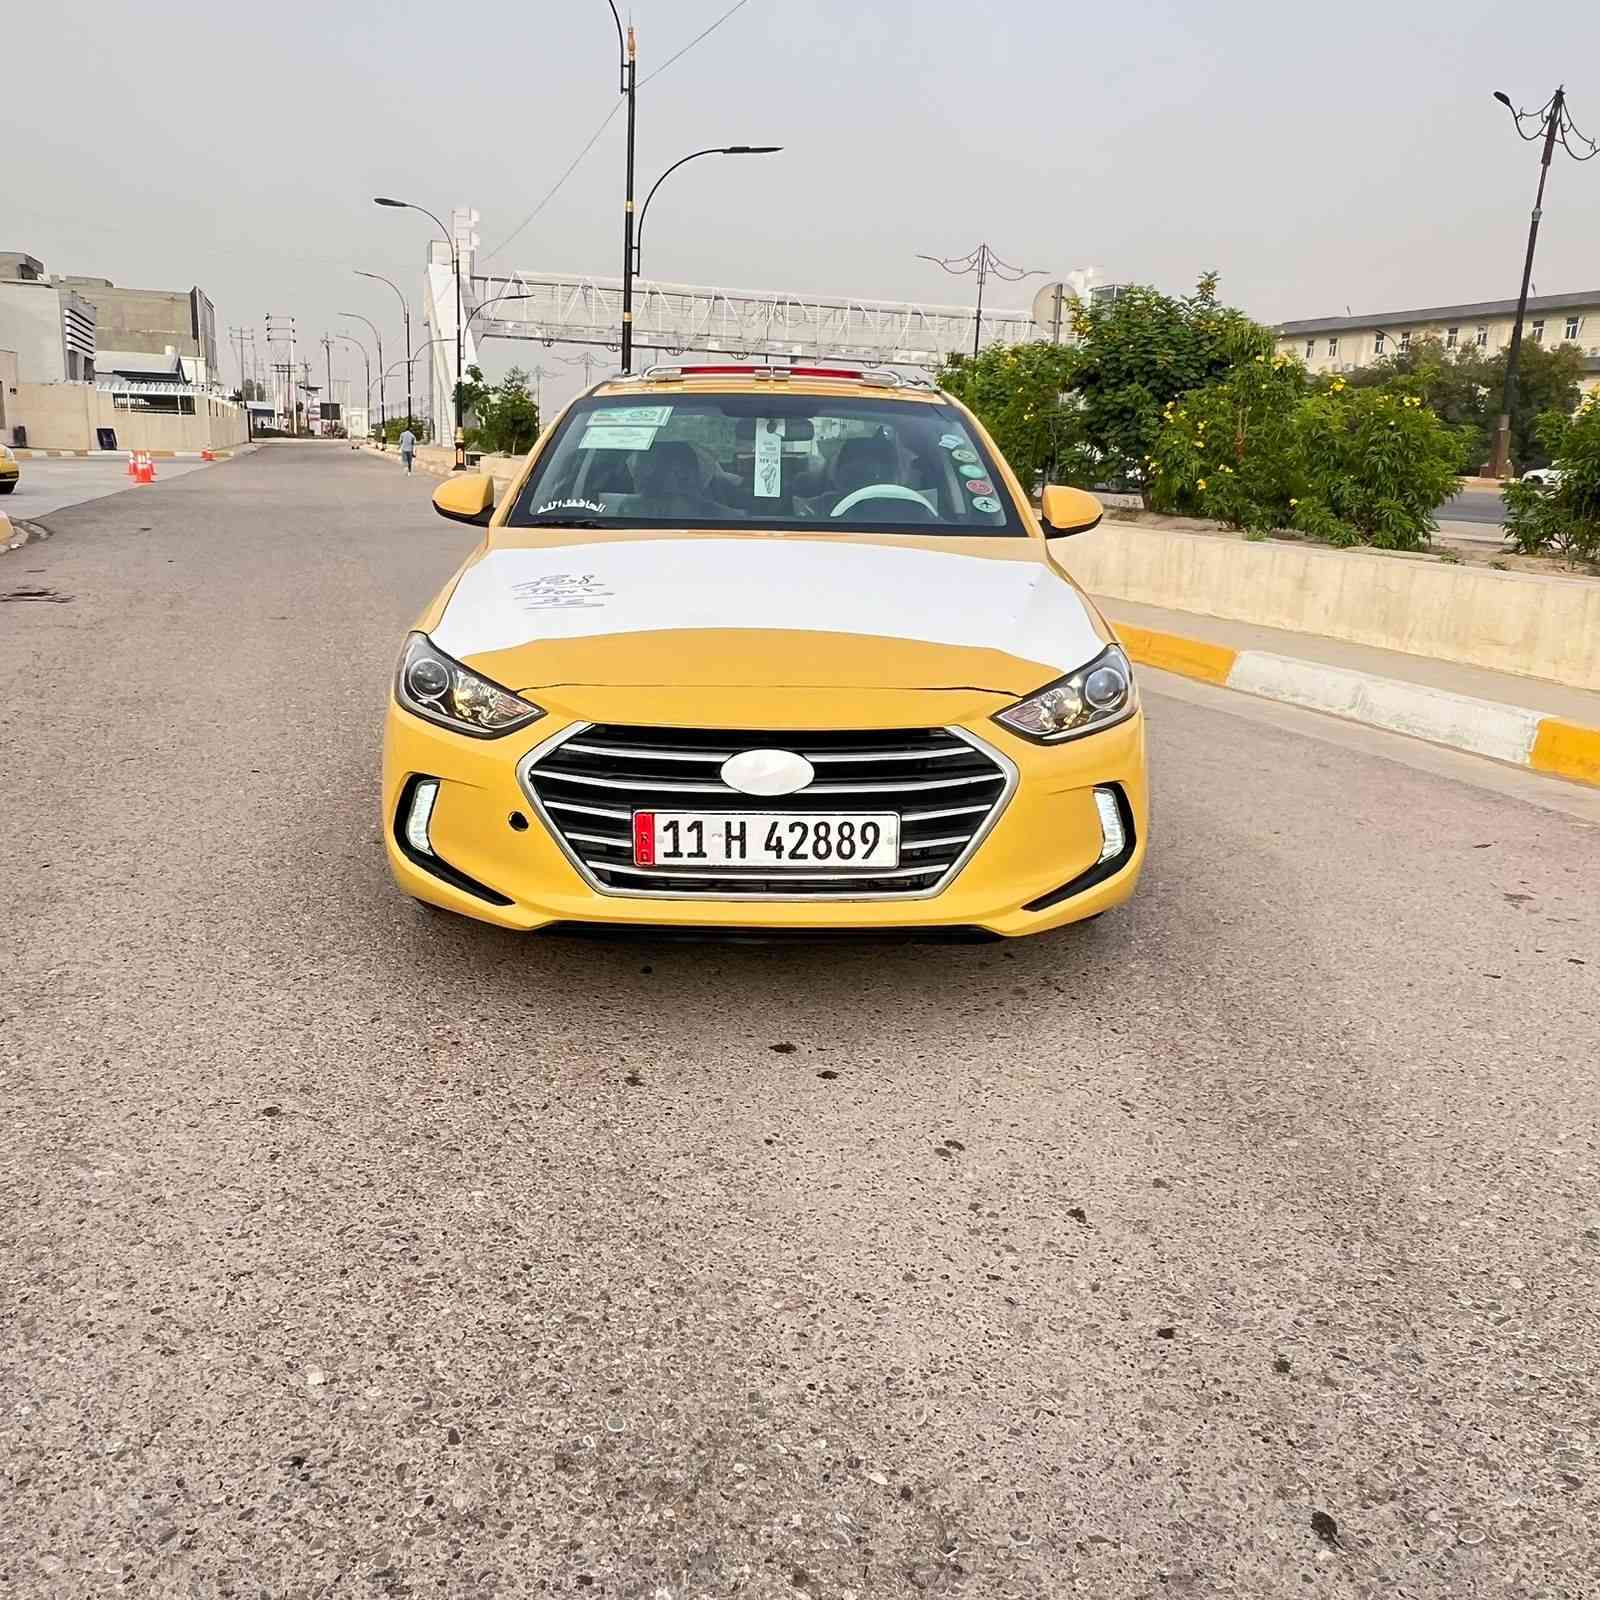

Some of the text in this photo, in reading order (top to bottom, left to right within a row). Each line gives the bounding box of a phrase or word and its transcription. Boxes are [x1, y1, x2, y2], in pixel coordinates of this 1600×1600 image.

[663, 820, 881, 860] 11 H 42889
